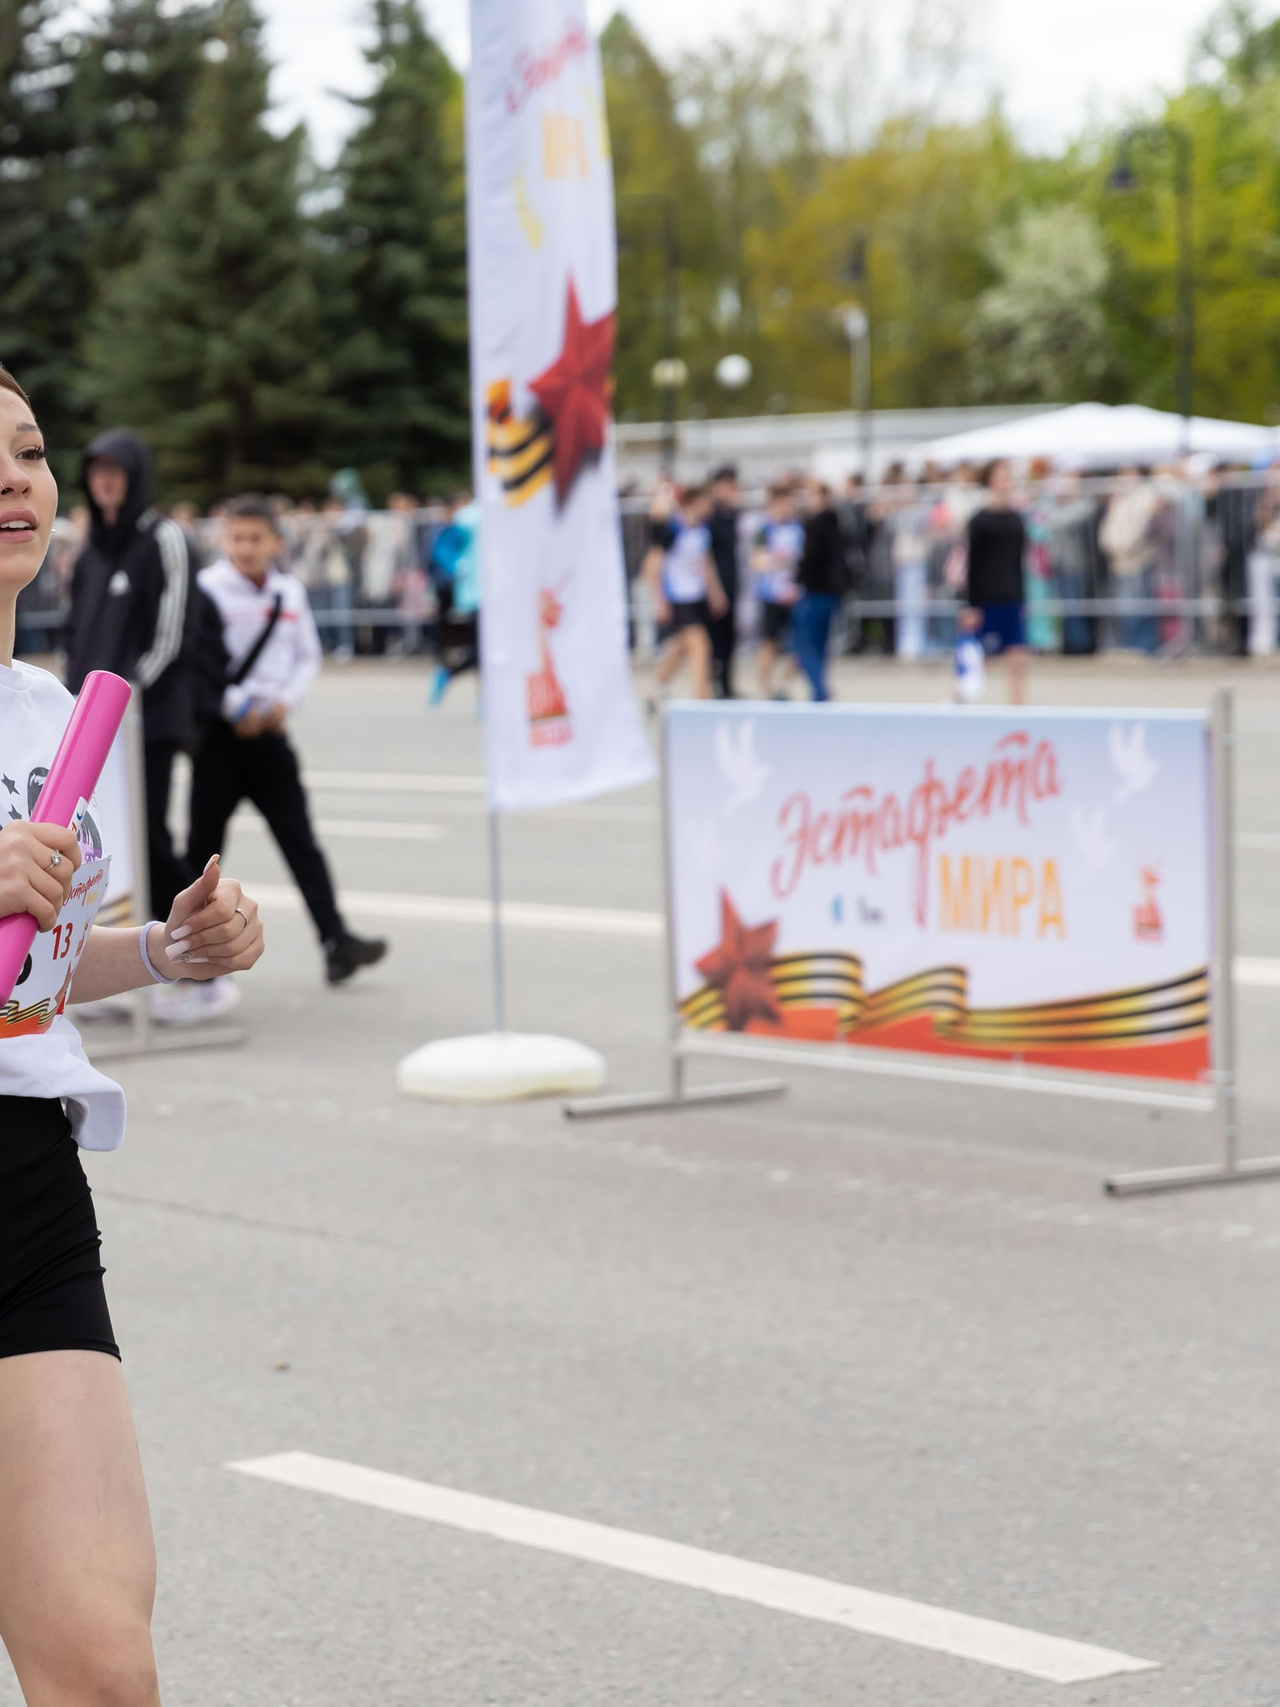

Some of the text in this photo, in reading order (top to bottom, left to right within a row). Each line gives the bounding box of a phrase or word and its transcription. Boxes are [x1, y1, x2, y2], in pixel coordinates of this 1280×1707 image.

[771, 730, 1065, 928] Эстафета
[939, 854, 1066, 940] МИРА
[52, 922, 73, 960] 13
